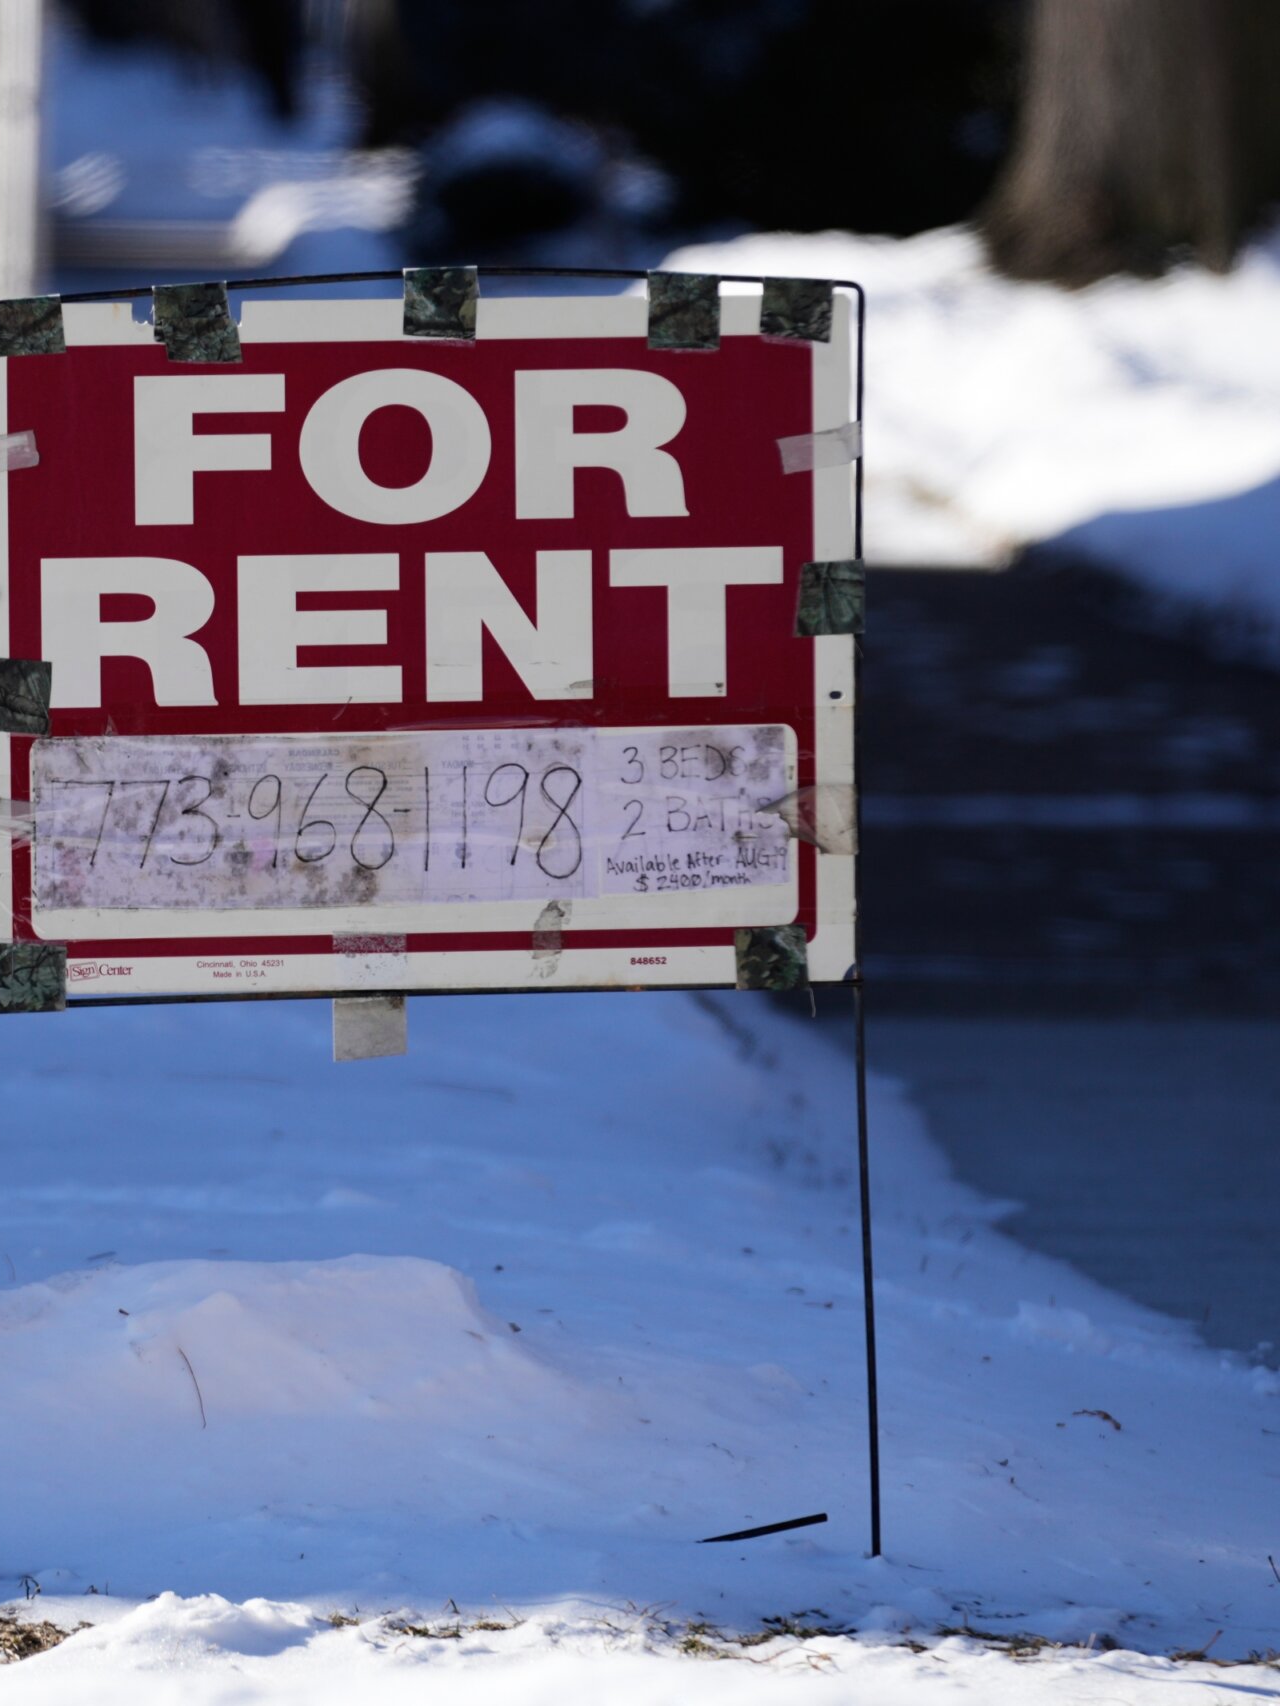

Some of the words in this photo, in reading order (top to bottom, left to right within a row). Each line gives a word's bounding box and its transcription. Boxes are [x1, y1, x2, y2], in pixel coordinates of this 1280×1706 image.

[133, 367, 690, 526] FOR
[40, 546, 784, 709] RENT
[621, 746, 645, 785] 3
[659, 744, 748, 782] BEDS
[51, 762, 583, 880] 773-968-1198
[621, 799, 646, 840] 2
[606, 853, 681, 876] Available
[687, 851, 723, 869] After
[72, 965, 96, 978] Sign
[98, 963, 134, 976] Center
[196, 960, 236, 968] Cincinnati,
[239, 959, 258, 968] Ohio
[261, 959, 284, 967] 45231
[212, 970, 233, 978] Made
[630, 956, 668, 966] 848652
